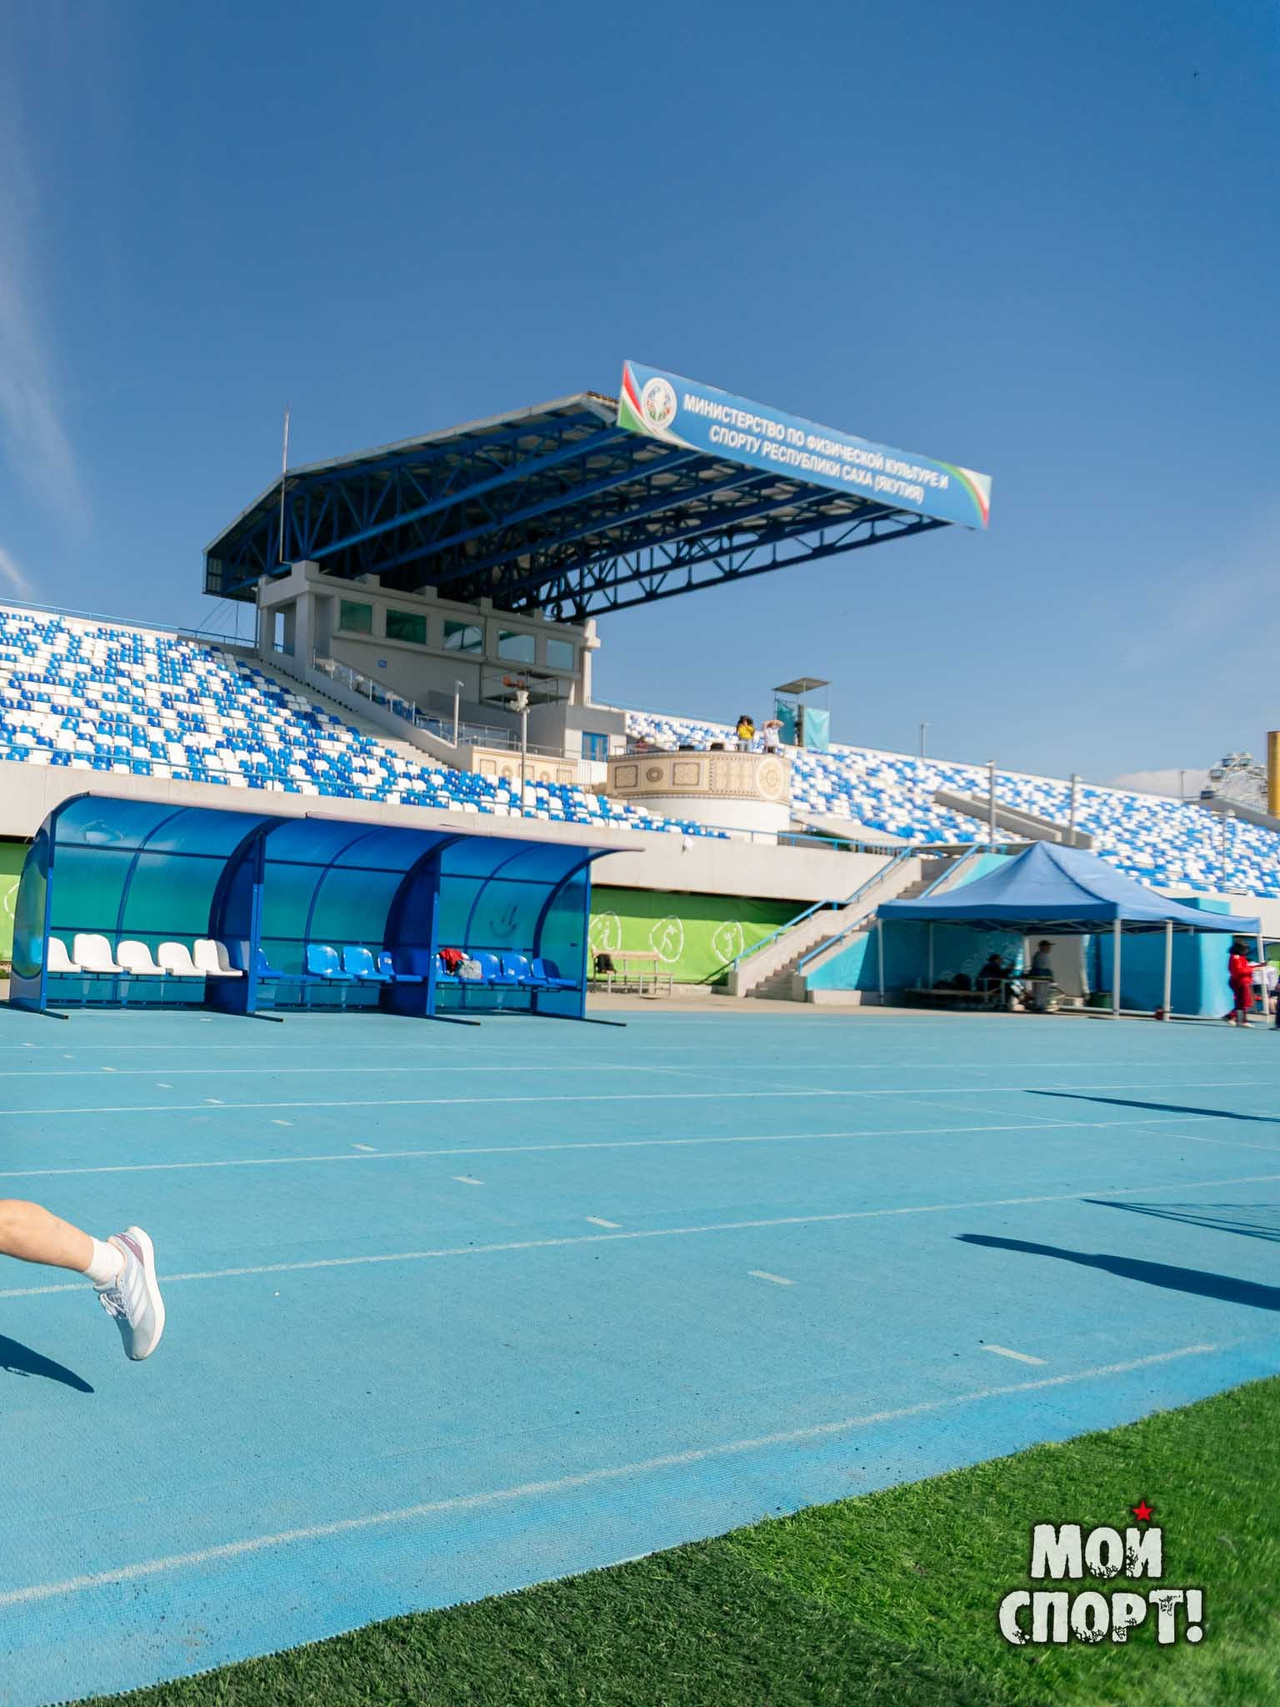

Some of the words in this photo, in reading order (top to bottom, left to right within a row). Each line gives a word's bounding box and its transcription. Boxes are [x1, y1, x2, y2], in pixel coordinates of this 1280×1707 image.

[683, 393, 786, 440] МИНИСТЕРСТВО
[787, 427, 805, 447] ПО
[806, 434, 883, 470] ФИЗИЧЕСКОЙ
[885, 457, 940, 488] КУЛЬТУРЕ
[939, 474, 949, 489] И
[709, 425, 761, 453] СПОРТУ
[761, 440, 841, 478] РЕСПУБЛИКИ
[841, 465, 873, 486] САХА
[874, 474, 924, 504] (ЯКУТИЯ)
